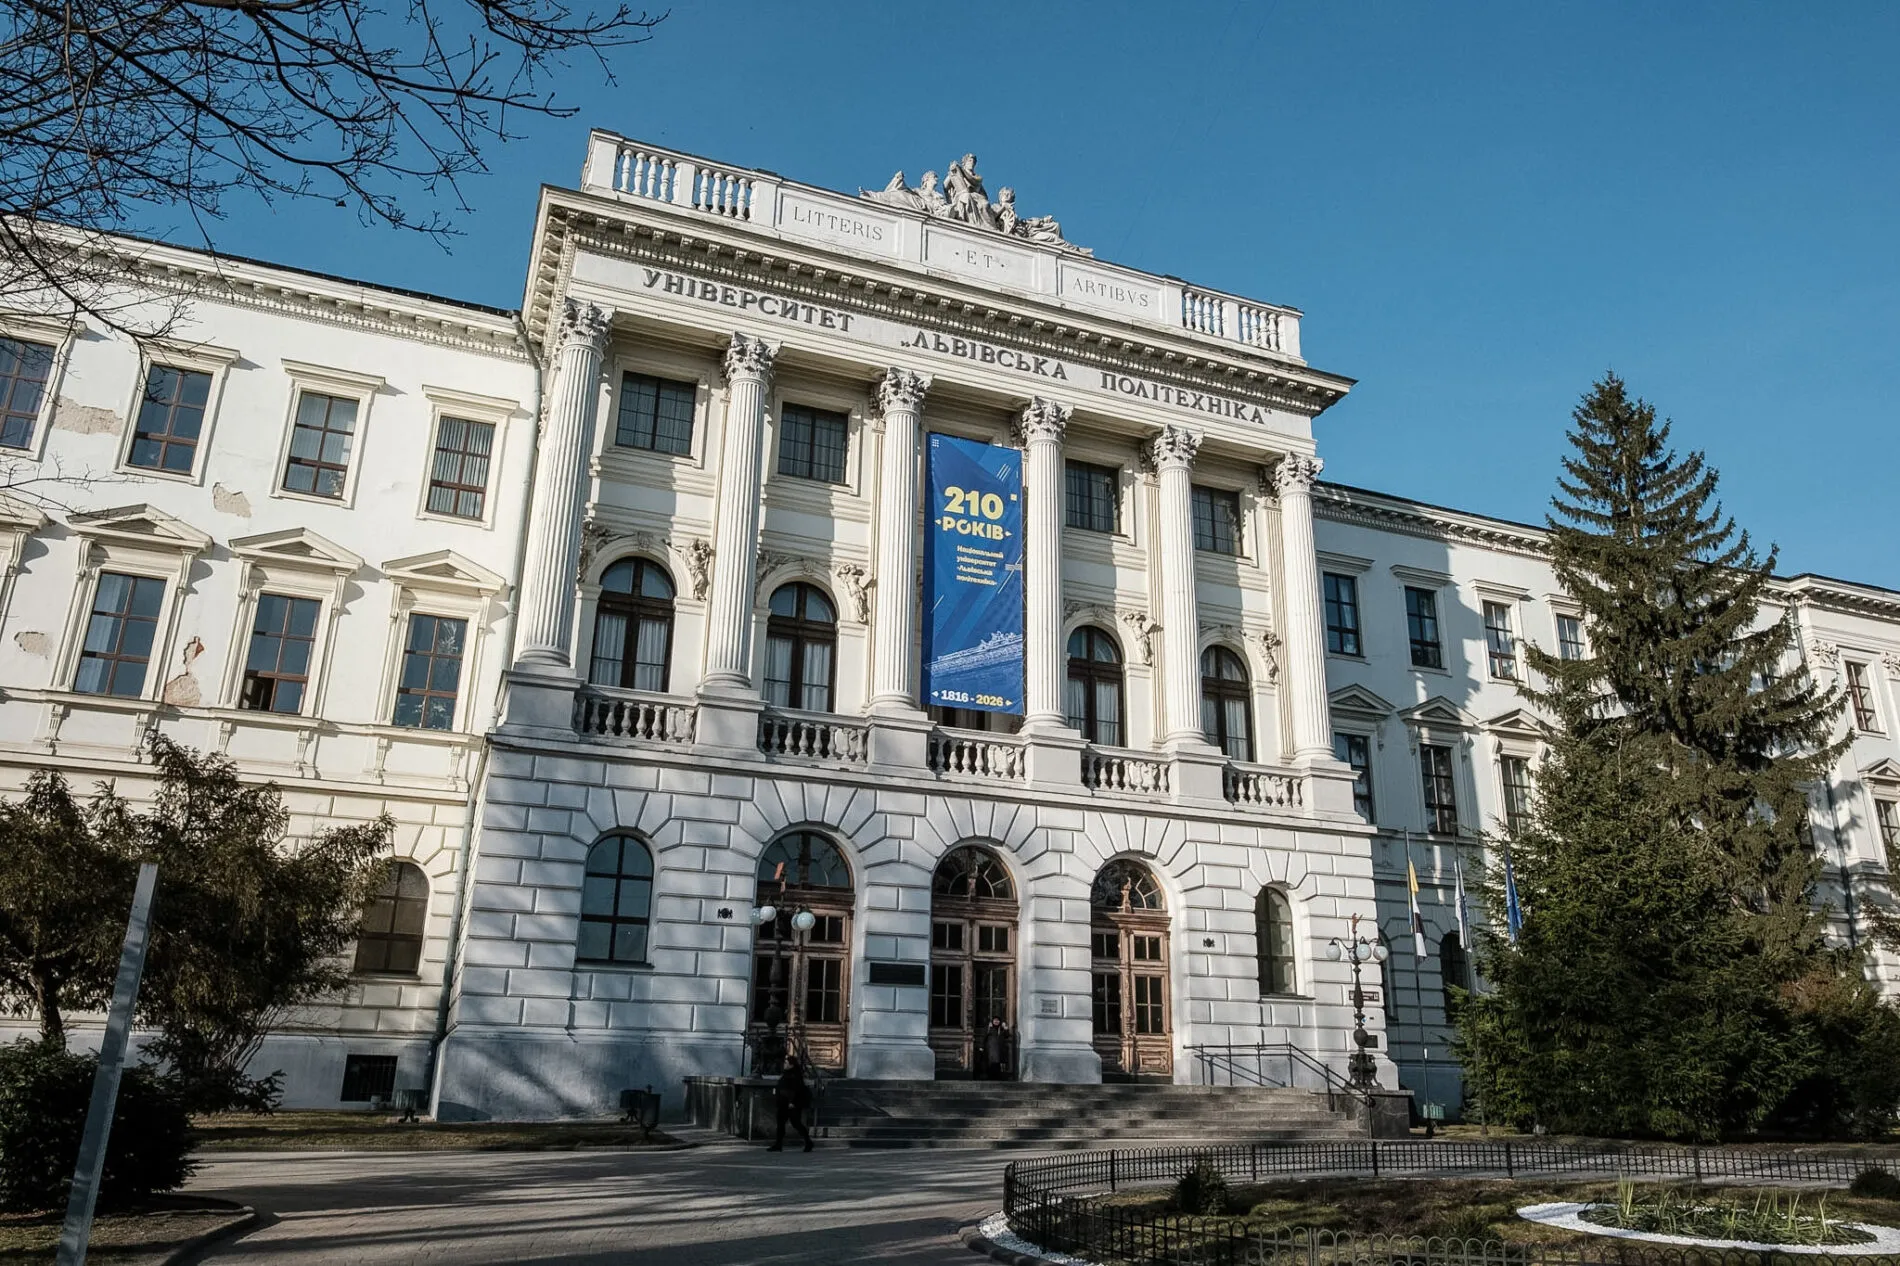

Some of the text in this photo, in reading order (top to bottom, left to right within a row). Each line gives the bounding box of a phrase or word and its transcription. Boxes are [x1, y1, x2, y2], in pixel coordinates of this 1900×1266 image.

[794, 206, 882, 240] LITTERIS
[642, 267, 854, 332] УНІВЕРСИТЕТ
[1072, 278, 1149, 308] ARTIBVS
[944, 486, 1004, 520] 210
[942, 516, 1004, 541] РОКІВ
[941, 690, 969, 702] 1816
[976, 694, 1004, 706] 2026
